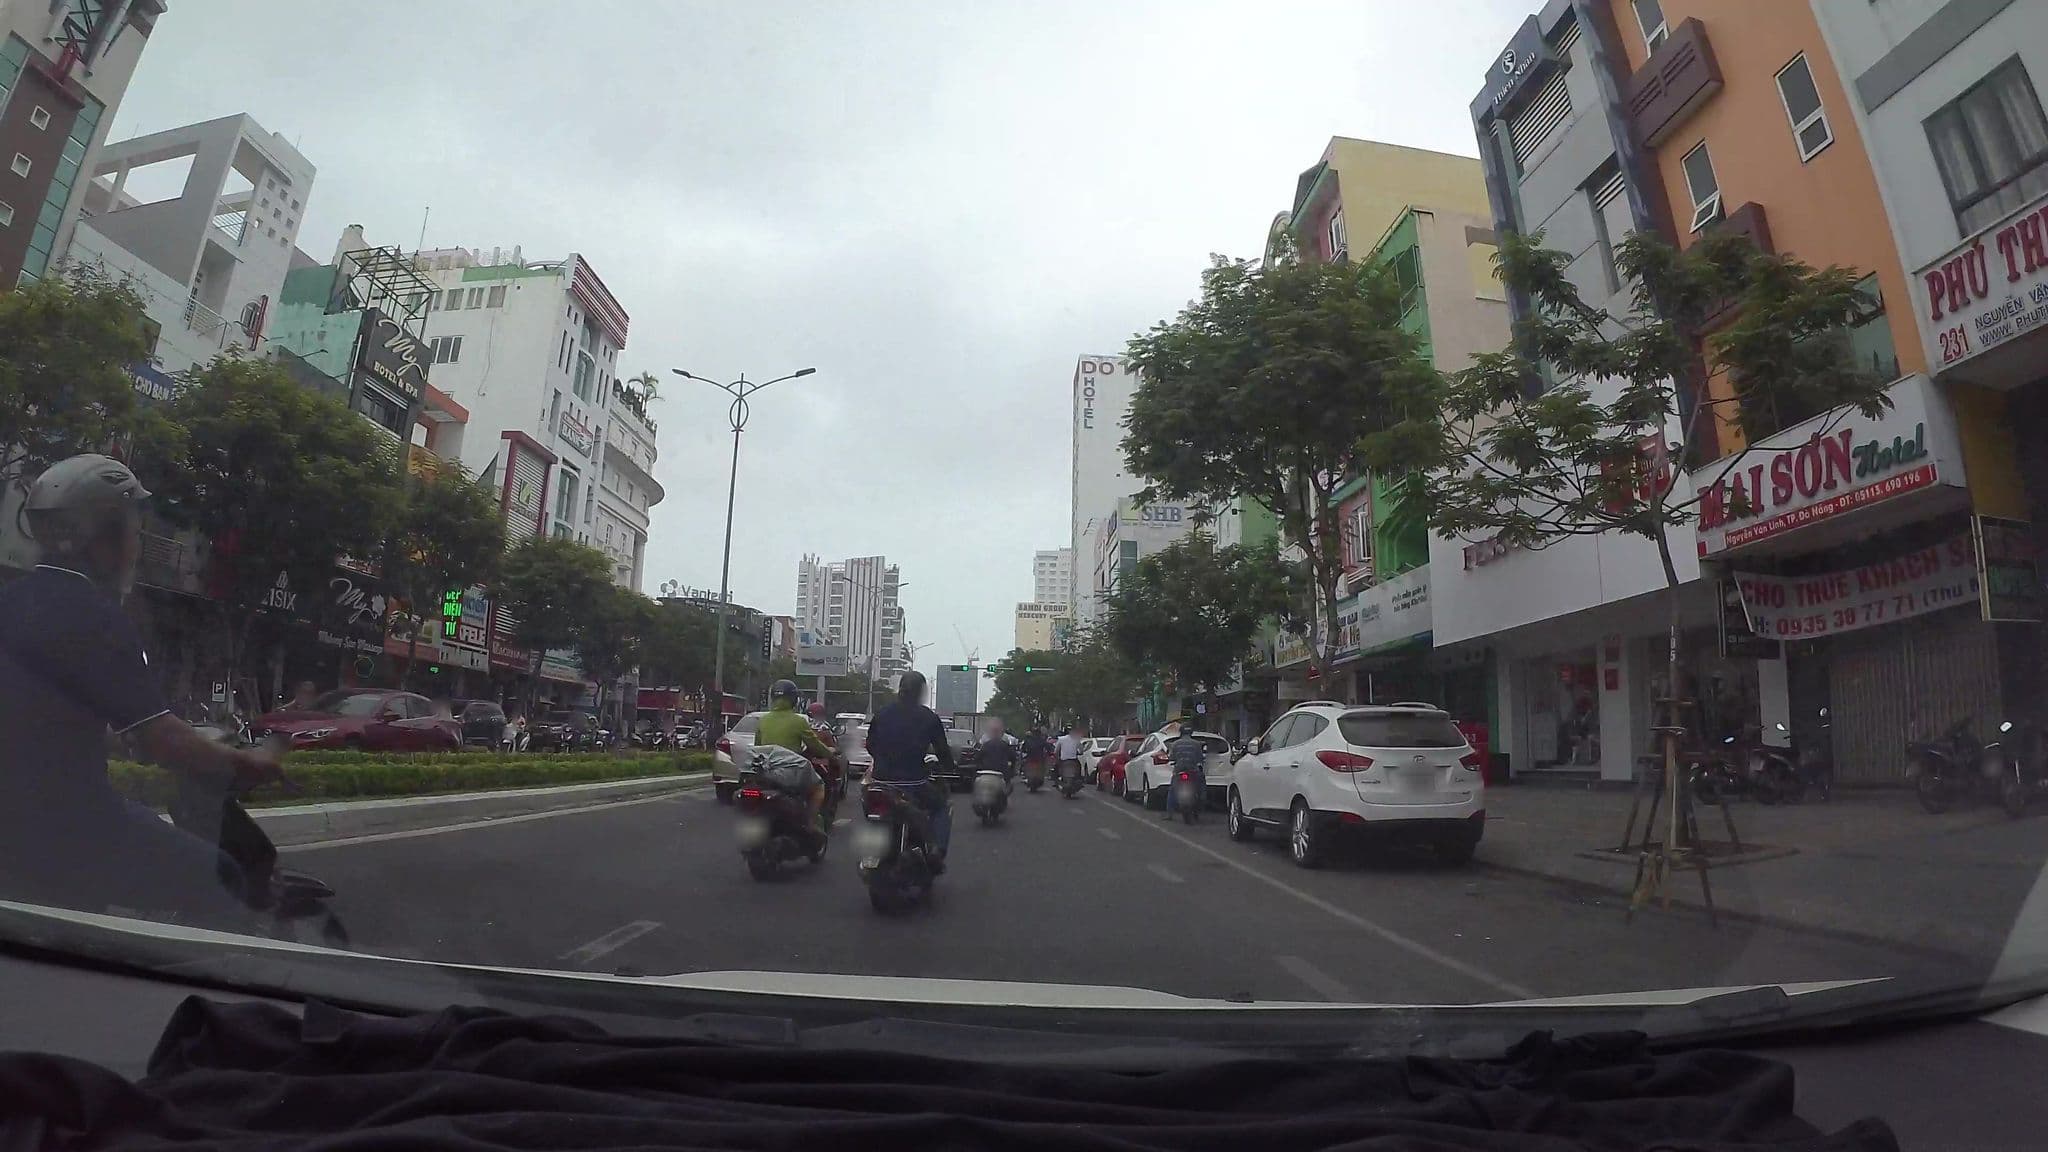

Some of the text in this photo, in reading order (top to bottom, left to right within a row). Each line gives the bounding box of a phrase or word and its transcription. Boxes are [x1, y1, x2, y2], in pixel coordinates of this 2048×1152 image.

[1924, 236, 1989, 321] PHÚ
[377, 318, 427, 381] My
[1939, 324, 1970, 363] 231
[1083, 377, 1096, 430] HOTEL
[1697, 464, 1764, 532] MAI
[1770, 428, 1853, 507] SƠN
[1852, 422, 1929, 478] Hotel
[1885, 477, 1902, 493] 690
[1903, 470, 1921, 486] 196
[1142, 505, 1183, 522] SHB
[1741, 580, 1785, 609] CHO
[1776, 613, 1827, 636] 0935
[1859, 600, 1886, 621] 77
[1893, 595, 1916, 615] 71
